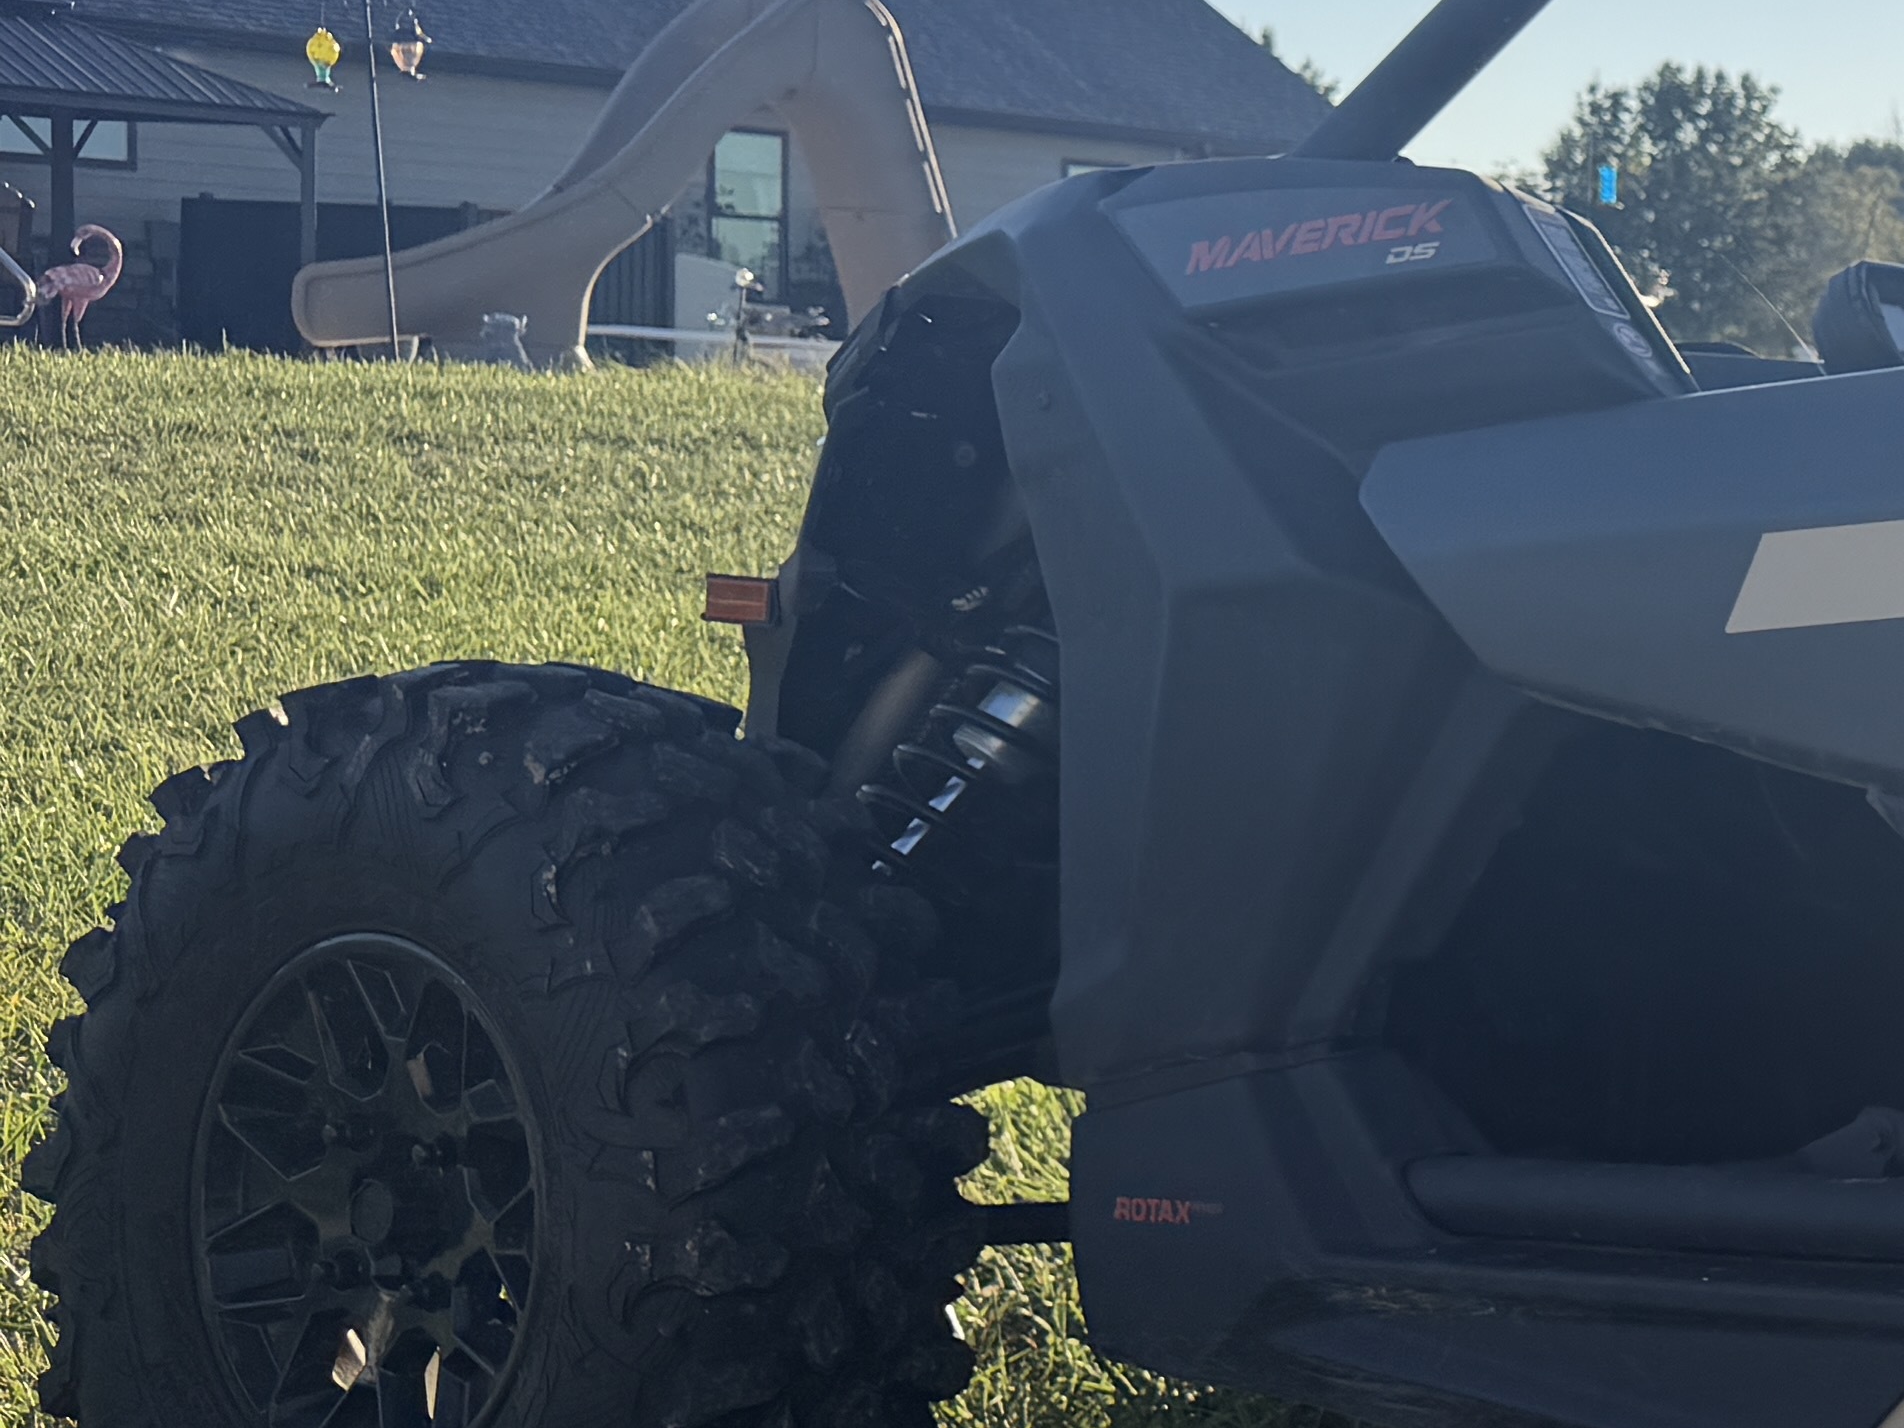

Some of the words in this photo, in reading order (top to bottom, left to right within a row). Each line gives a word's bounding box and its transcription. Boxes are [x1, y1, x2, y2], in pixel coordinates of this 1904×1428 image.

[1186, 200, 1450, 274] MAVERICK
[1386, 243, 1440, 264] DS
[1113, 1197, 1191, 1224] ROTAX
